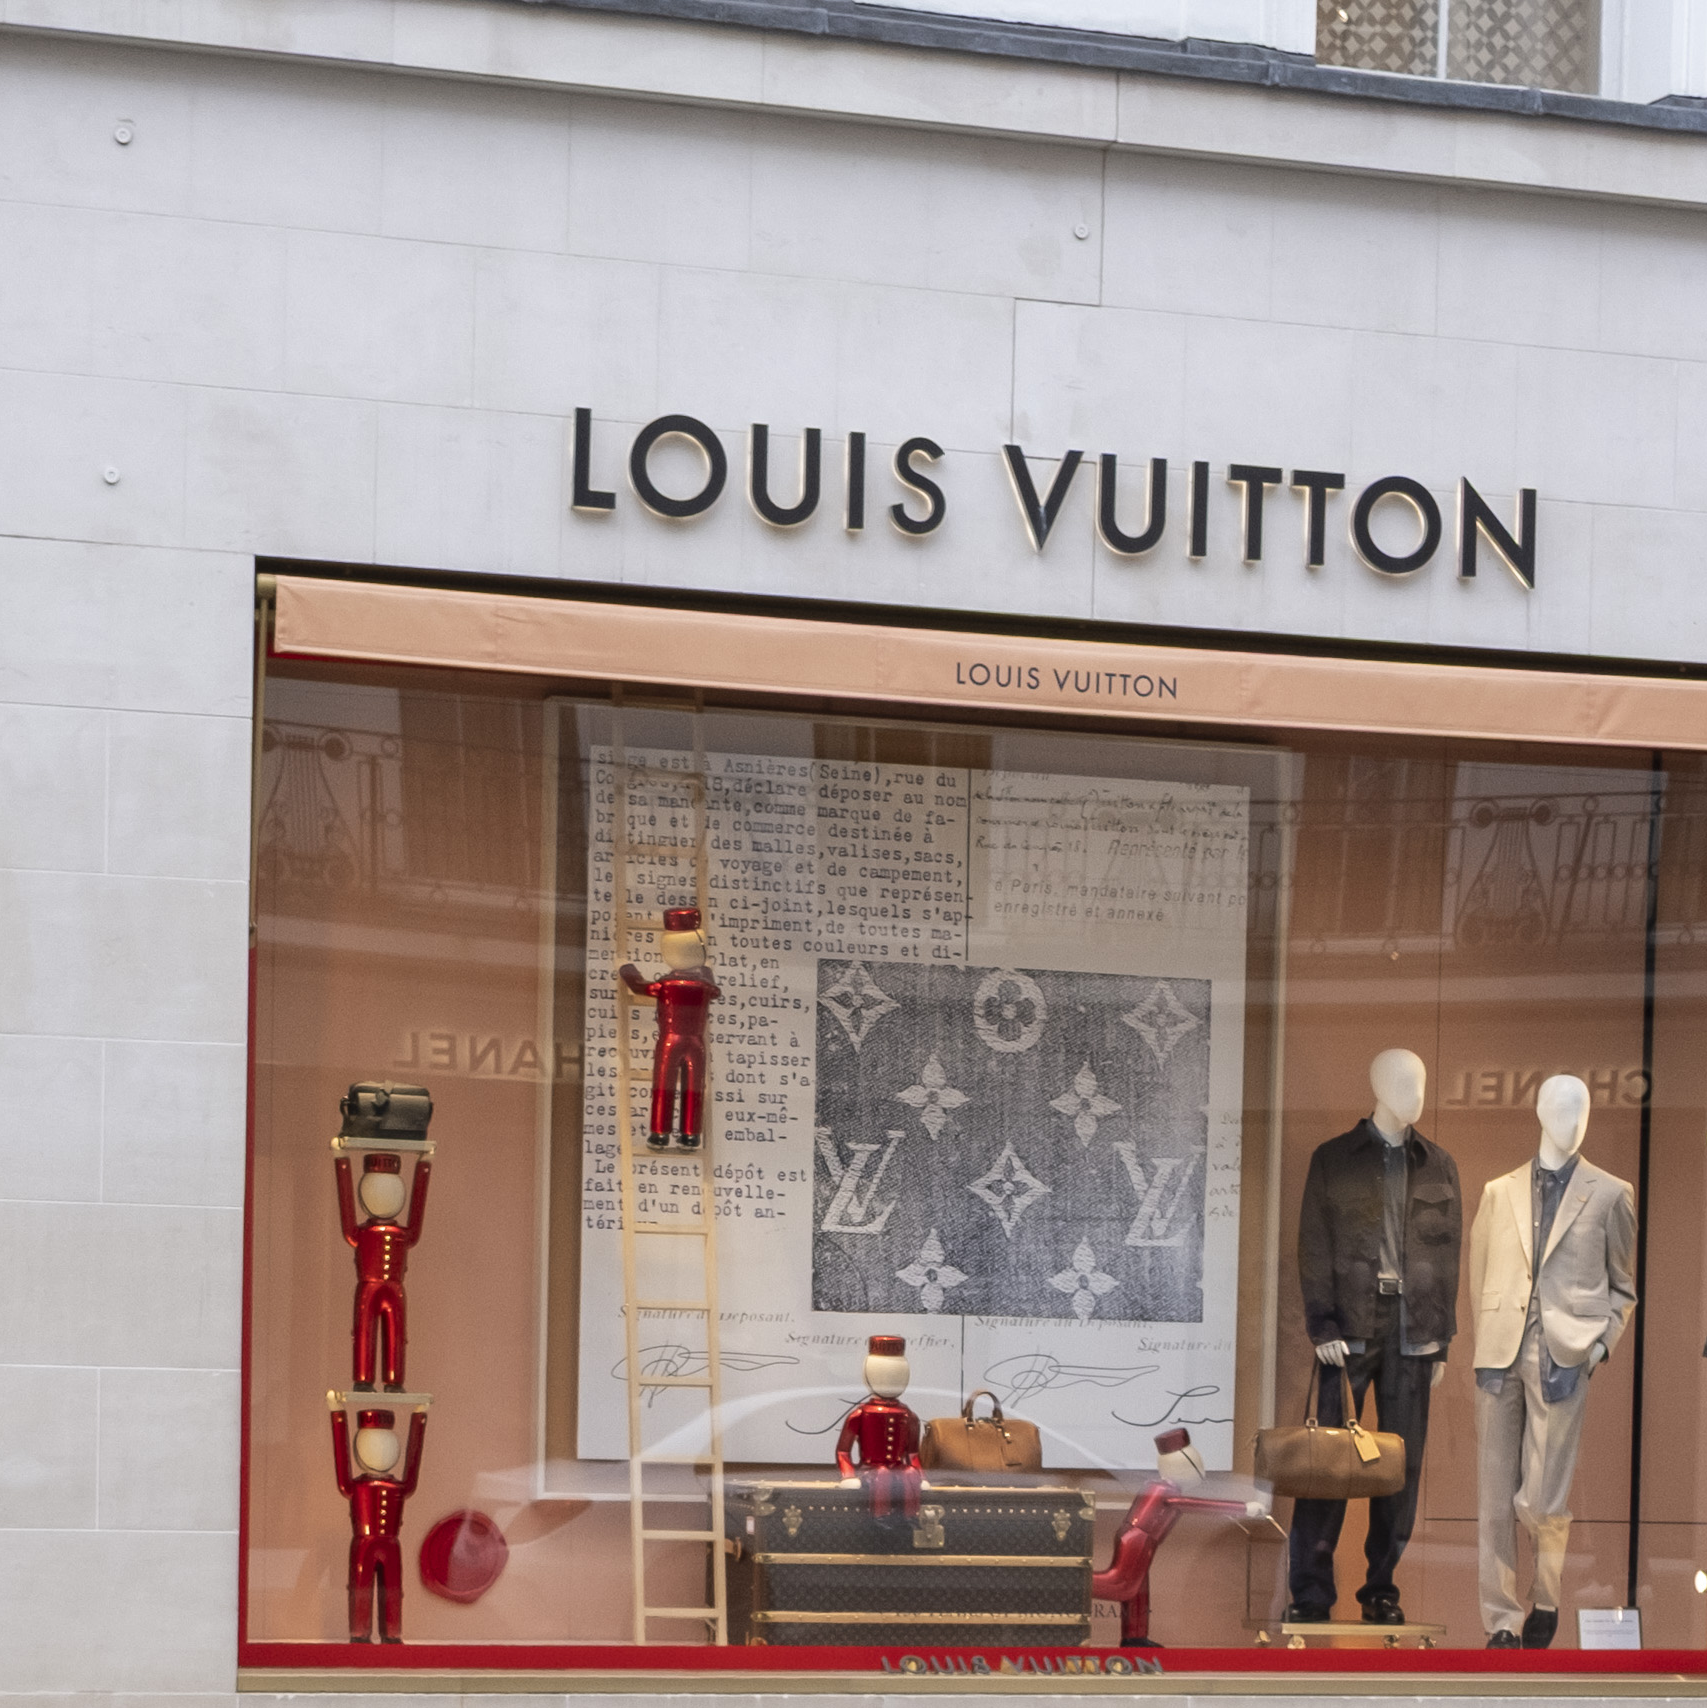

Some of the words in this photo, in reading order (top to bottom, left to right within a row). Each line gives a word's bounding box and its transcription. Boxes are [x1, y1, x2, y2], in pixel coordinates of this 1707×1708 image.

[573, 406, 945, 535] LOUIS
[1003, 444, 1536, 588] VUITTON
[956, 661, 1041, 691] LOUIS
[1053, 668, 1178, 701] VUITTON
[659, 756, 690, 770] est
[936, 772, 956, 788] du
[819, 783, 892, 803] déposer
[903, 793, 924, 804] au
[934, 795, 967, 808] nom
[596, 790, 615, 804] de
[628, 794, 647, 806] sa
[817, 805, 880, 824] marque
[893, 809, 912, 823] de
[925, 810, 955, 826] fa-
[596, 809, 656, 830] brque
[670, 815, 689, 828] et
[733, 820, 815, 836] commerce
[828, 823, 912, 841] destinée
[923, 827, 934, 844] à
[711, 836, 742, 850] des
[719, 860, 782, 876] voyage
[794, 862, 814, 874] et
[827, 862, 847, 876] de
[859, 865, 962, 887] campement,
[637, 870, 698, 890] signes
[709, 875, 826, 895] distinctifs
[837, 886, 868, 901] que
[1067, 883, 1157, 902] mandataire
[626, 888, 644, 904] le
[657, 890, 718, 908] dessn
[729, 895, 911, 920] ci-joint,lesquels
[994, 899, 1077, 918] enregistré
[1085, 903, 1100, 918] et
[1107, 905, 1164, 921] annexé
[710, 912, 844, 936] 'impriment,de
[858, 921, 921, 939] toutes
[930, 928, 962, 940] ma-
[732, 935, 792, 951] toutes
[803, 939, 889, 956] couleurs
[900, 944, 919, 957] et
[932, 944, 962, 959] di-
[589, 988, 618, 1000] sur
[716, 973, 788, 993] relief,
[587, 1004, 640, 1020] cuis
[789, 1031, 800, 1048] à
[726, 1051, 810, 1068] tapisser
[586, 1062, 618, 1078] les
[725, 1069, 766, 1084] dont
[585, 1082, 616, 1101] git
[758, 1092, 788, 1104] sur
[585, 1104, 617, 1116] ces
[583, 1123, 616, 1136] mes
[725, 1127, 787, 1143] embal-
[595, 1159, 615, 1173] Le
[713, 1162, 765, 1183] dépôt
[777, 1169, 808, 1182] est
[584, 1178, 623, 1193] fait
[638, 1182, 659, 1194] en
[670, 1184, 786, 1200] renuvelle-
[583, 1199, 623, 1211] ment
[638, 1198, 679, 1214] d'un
[754, 1207, 786, 1219] an-
[1137, 1336, 1212, 1353] Signature
[881, 1654, 991, 1676] LOUIS
[1000, 1655, 1165, 1676] VUITTON
